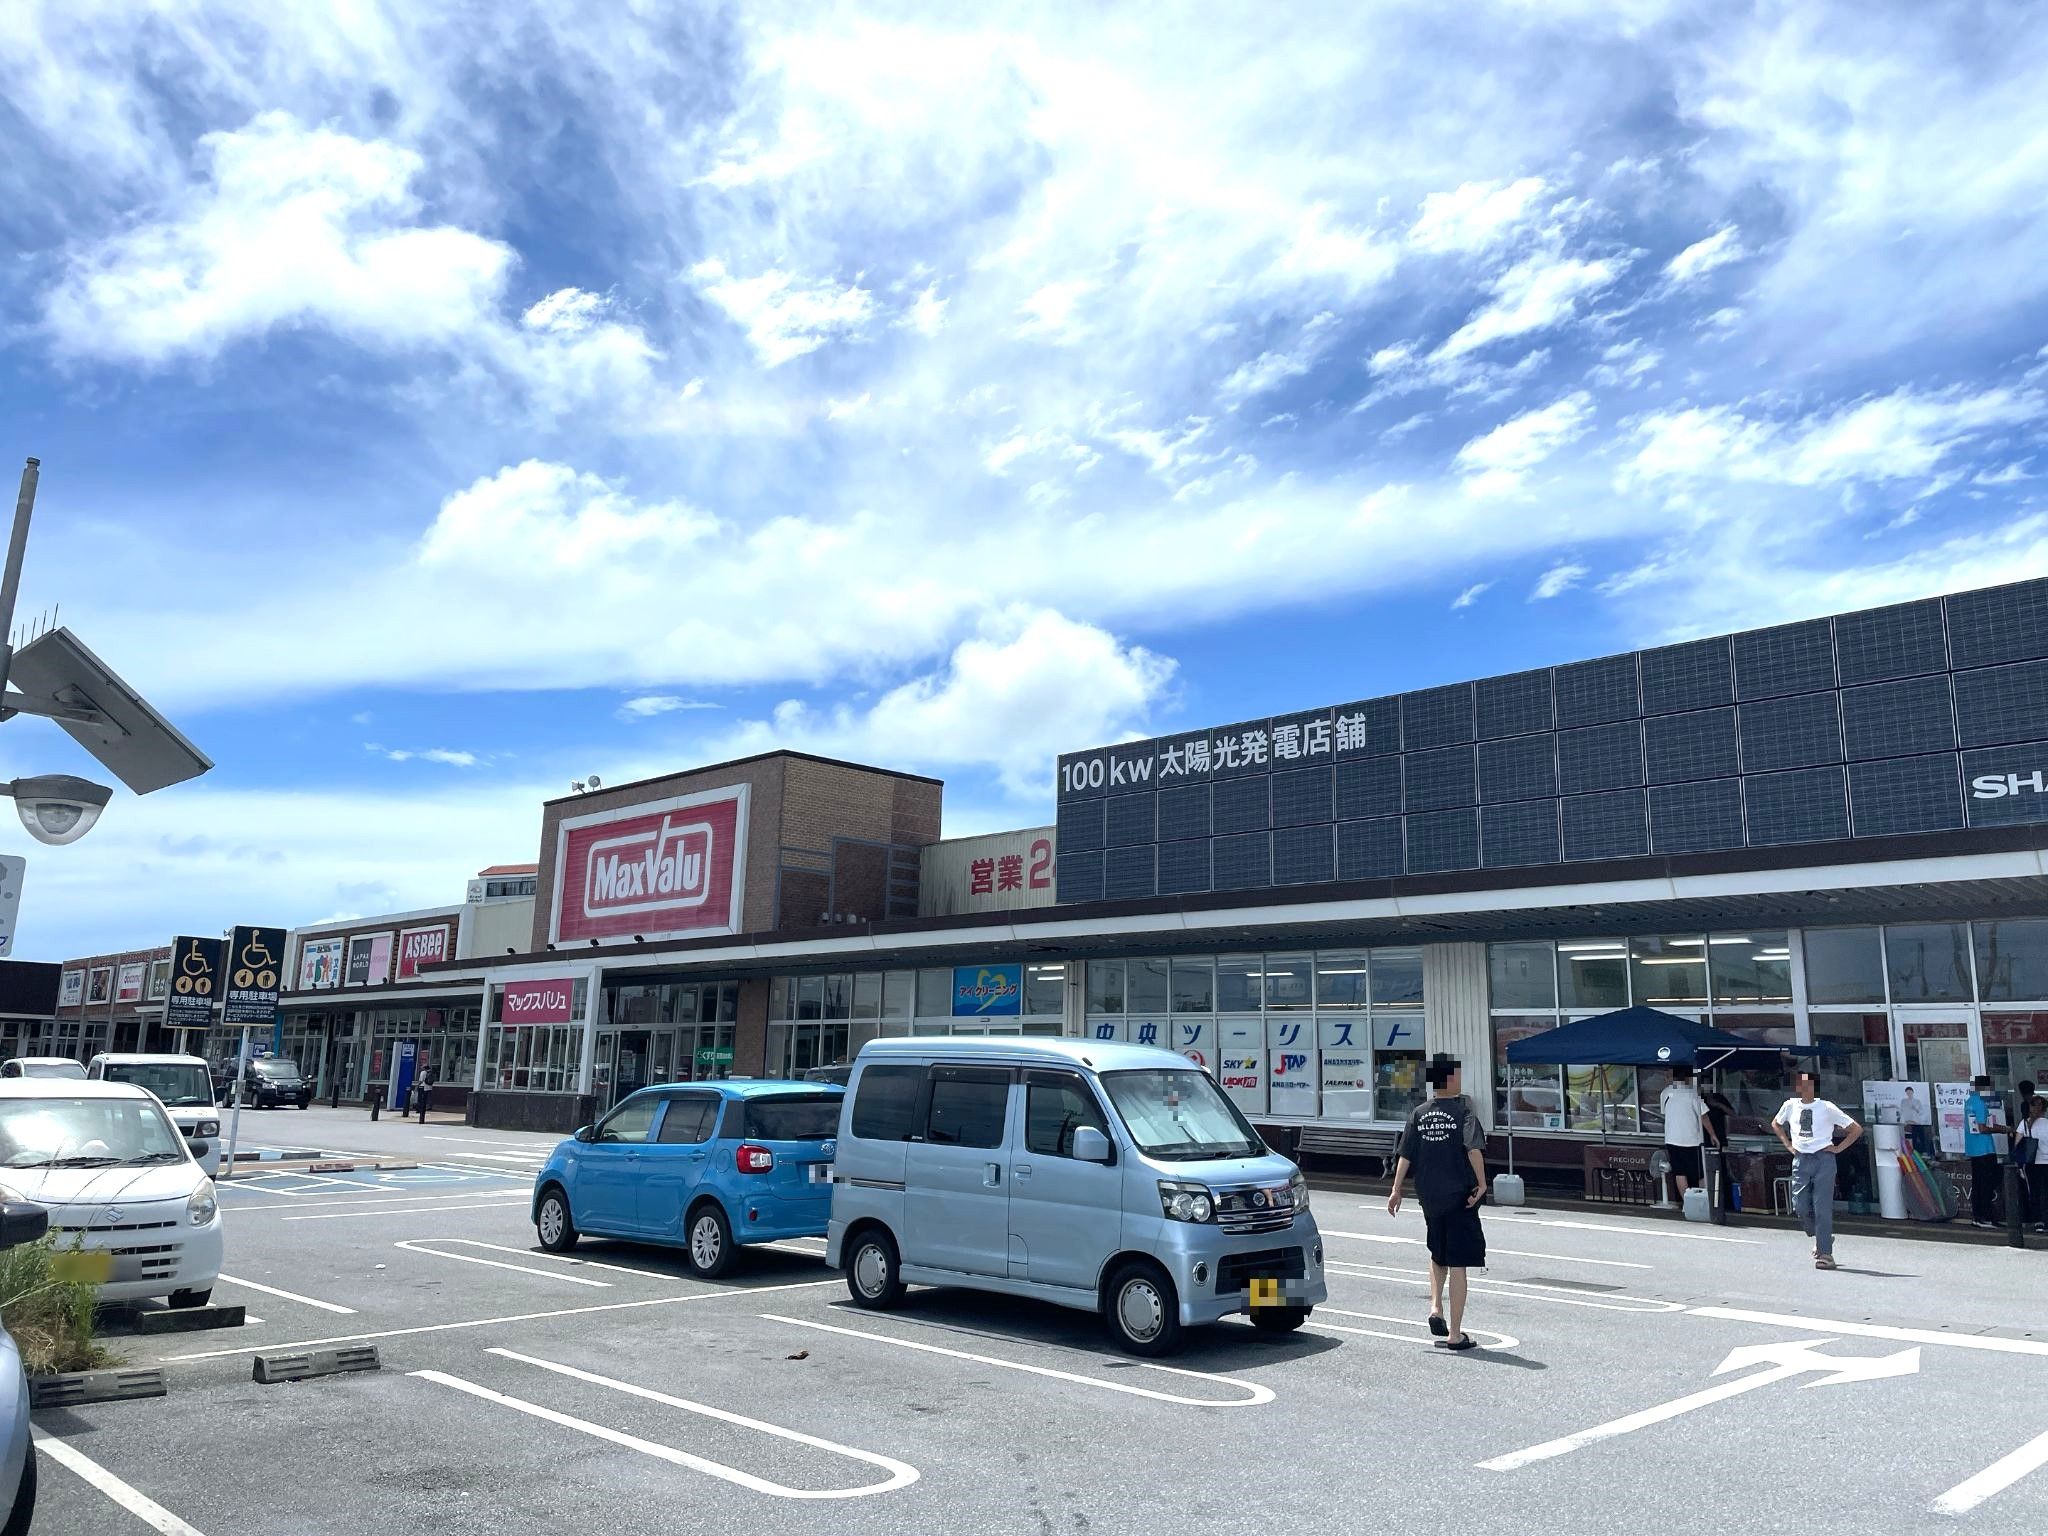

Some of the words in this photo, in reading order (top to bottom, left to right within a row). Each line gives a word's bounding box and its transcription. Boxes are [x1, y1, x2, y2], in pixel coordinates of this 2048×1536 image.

[1158, 712, 1366, 779] 太陽光発電店舗
[1972, 770, 2048, 799] SH
[594, 815, 701, 901] MaxValu
[970, 838, 1057, 896] 営業2
[405, 932, 443, 960] ASBee
[352, 961, 369, 969] WORLD
[171, 995, 213, 1006] 専用駐車場
[229, 990, 278, 1002] 専用駐車場
[508, 990, 567, 1012] マックスバリュ
[1095, 1023, 1412, 1047] 中央ツーリスト
[1223, 1059, 1243, 1069] SKY
[1417, 1123, 1458, 1131] BLLABONG
[1608, 1156, 1646, 1164] FRECIOUS
